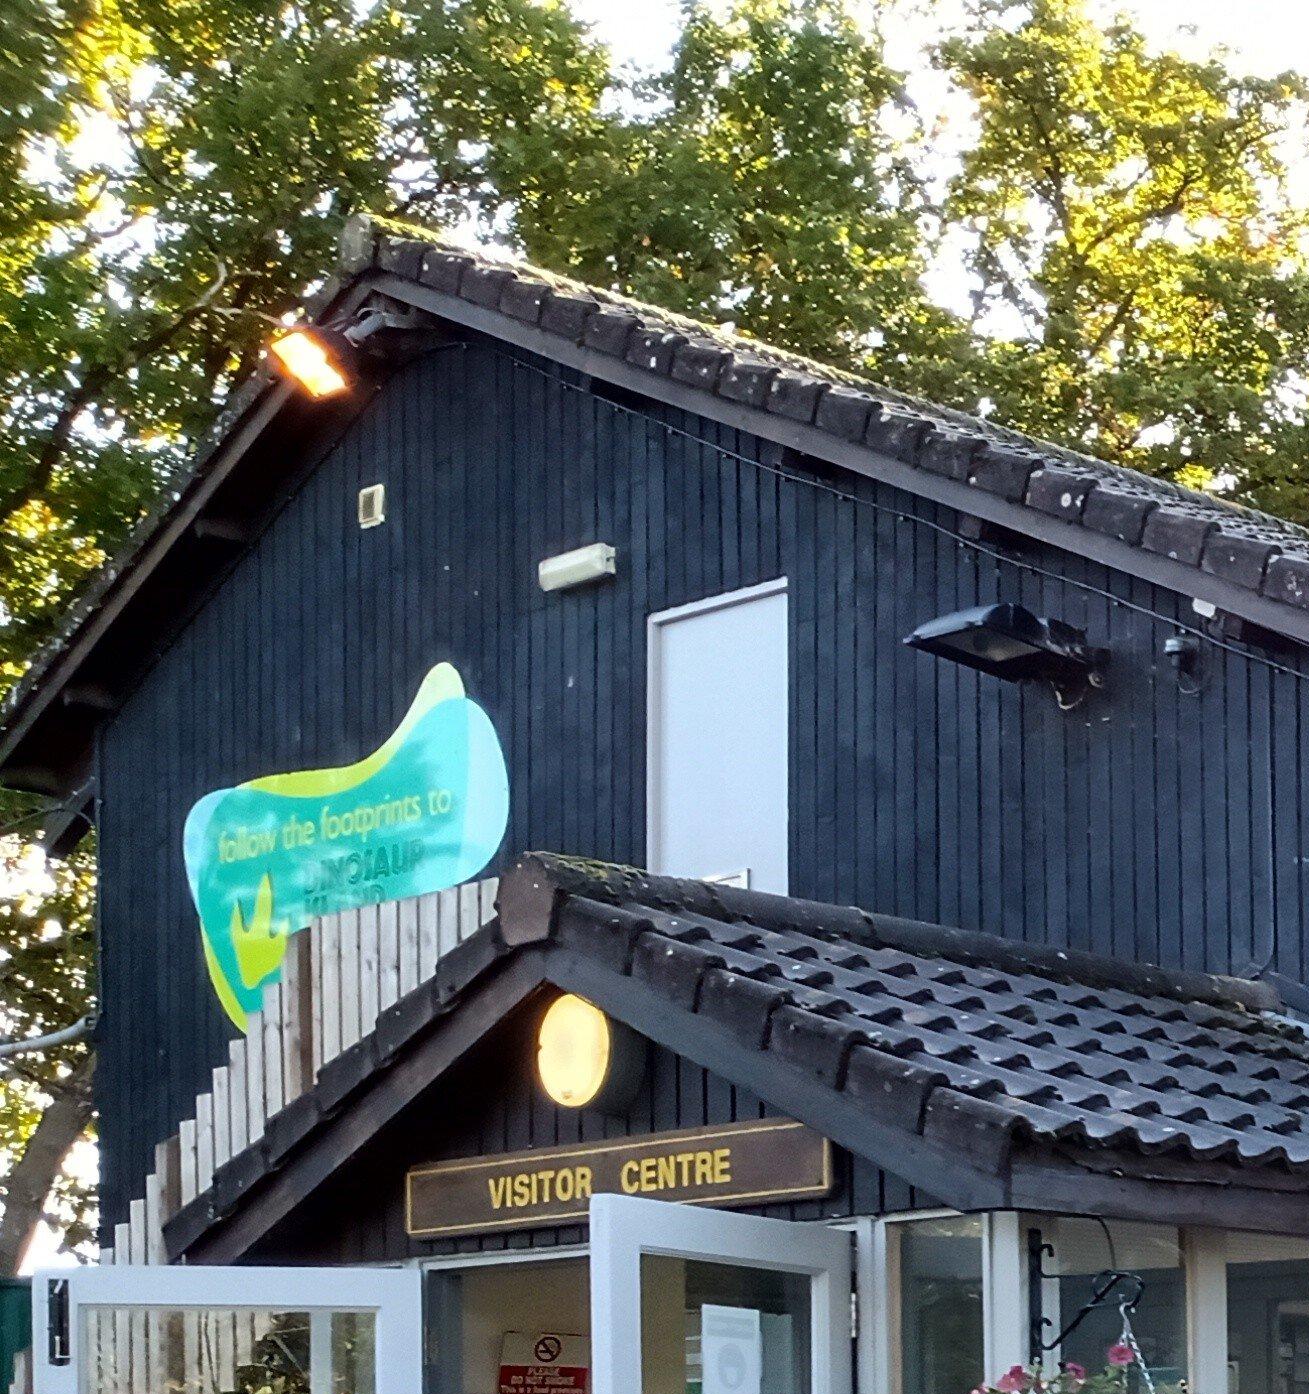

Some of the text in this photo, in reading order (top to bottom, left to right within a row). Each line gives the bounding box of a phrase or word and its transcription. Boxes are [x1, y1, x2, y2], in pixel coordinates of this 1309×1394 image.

[219, 790, 451, 863] follow the footprints to
[488, 1148, 732, 1210] VISITOR CENTRE
